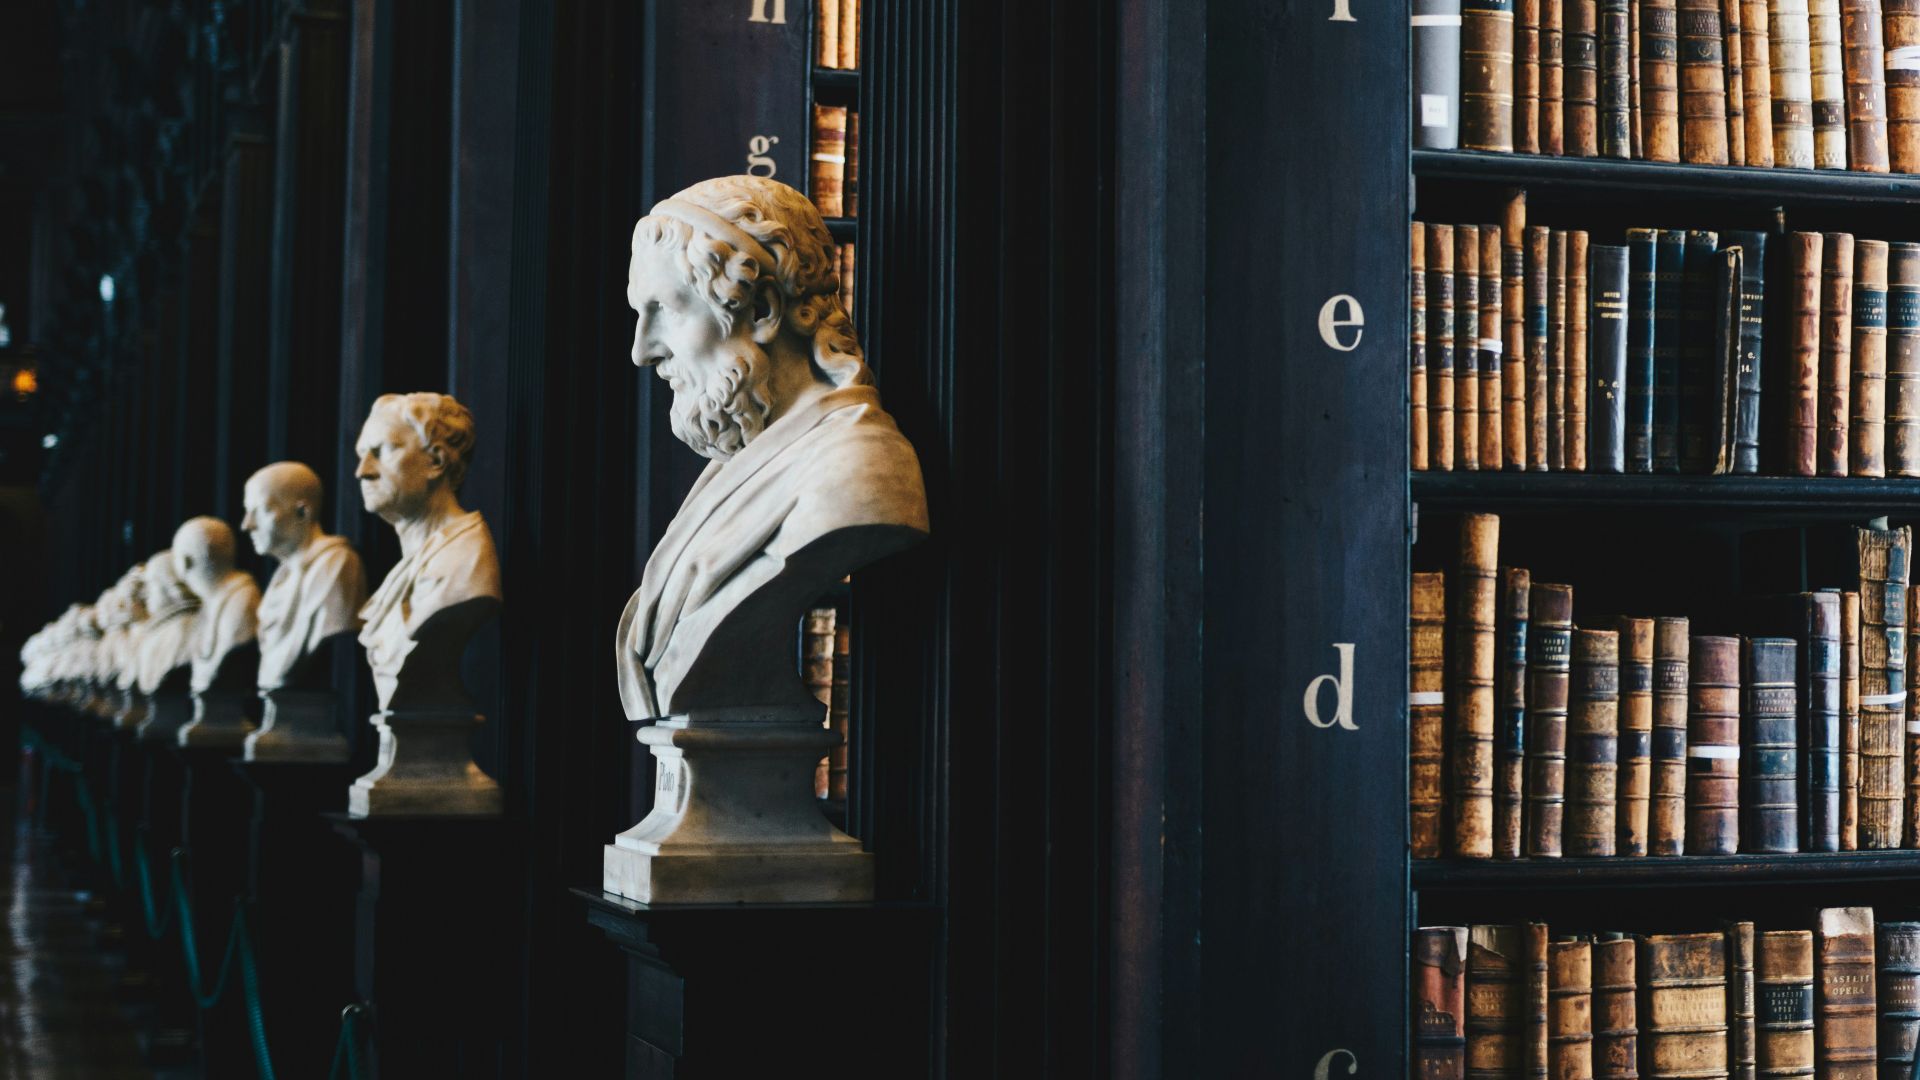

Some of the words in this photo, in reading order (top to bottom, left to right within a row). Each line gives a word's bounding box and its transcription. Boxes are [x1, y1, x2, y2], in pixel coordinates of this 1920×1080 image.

[747, 135, 779, 178] g
[1318, 294, 1364, 351] e
[1303, 643, 1360, 730] d
[658, 761, 675, 792] Plato
[1832, 986, 1865, 996] OPERA
